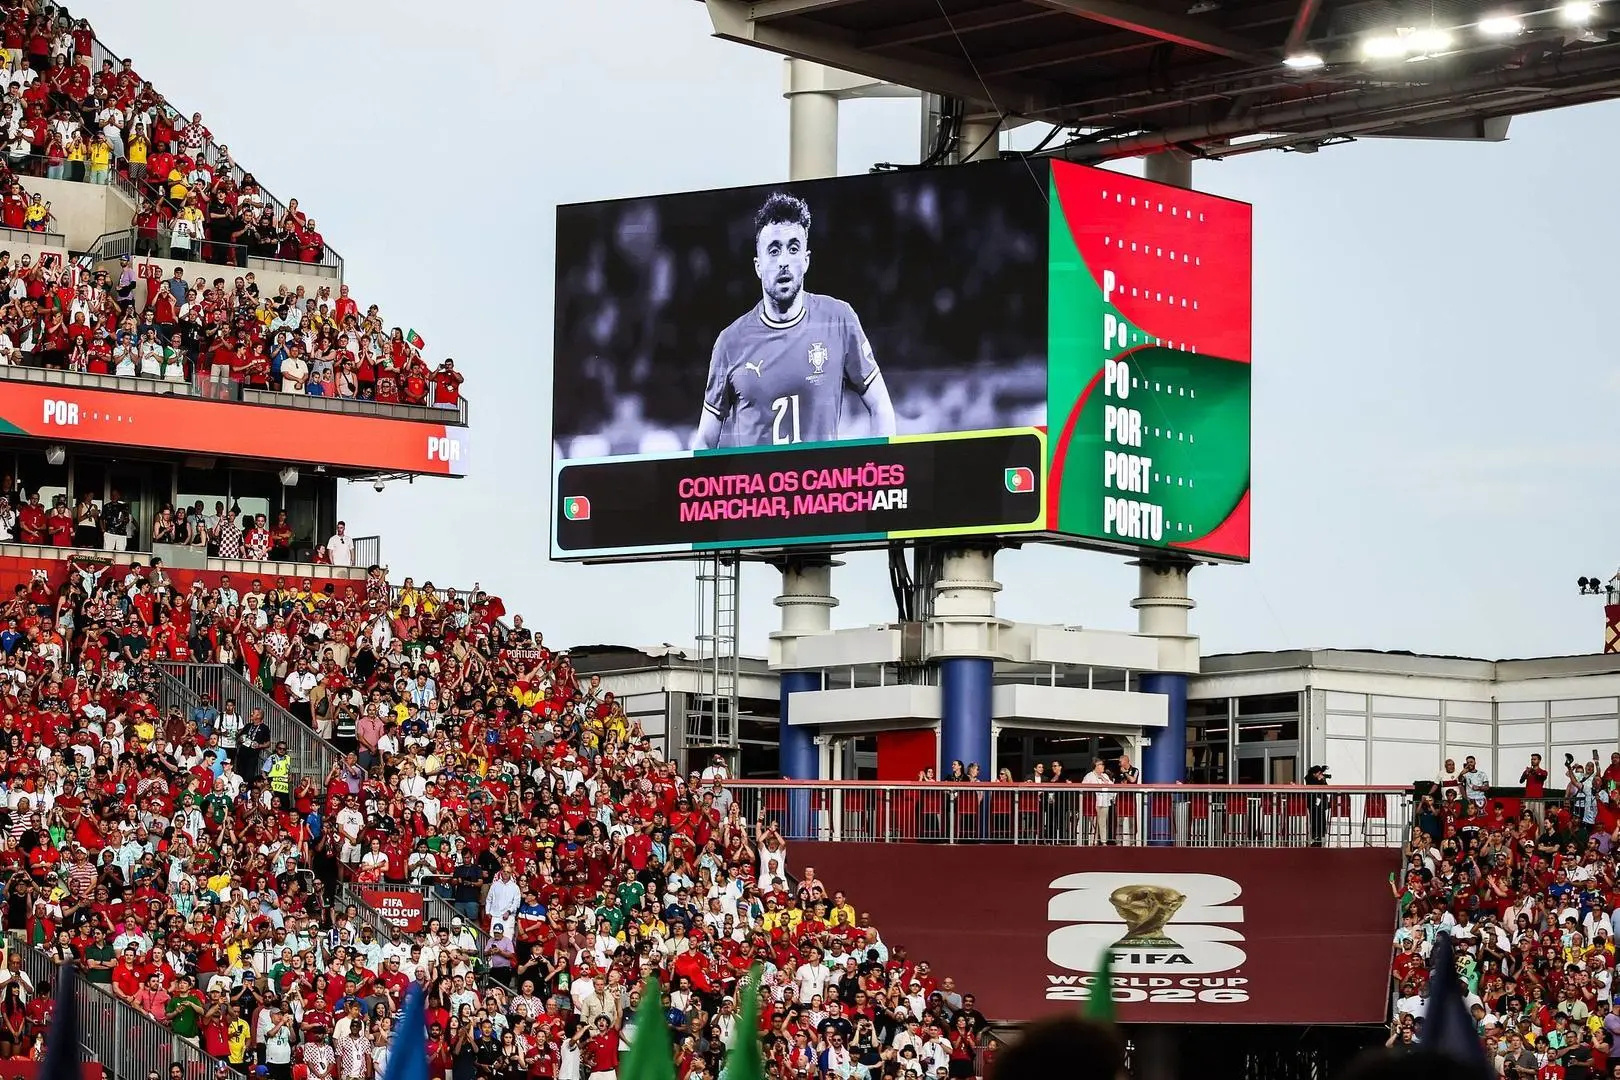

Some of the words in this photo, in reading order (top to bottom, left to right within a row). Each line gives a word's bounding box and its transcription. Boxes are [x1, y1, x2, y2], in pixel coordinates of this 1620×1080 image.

[771, 393, 803, 445] 21
[678, 472, 765, 499] CONTRA
[768, 470, 799, 492] OS
[801, 462, 905, 490] CANHÕES
[679, 495, 790, 523] MARCHAR,
[798, 487, 908, 514] MARCHAR!
[506, 649, 543, 660] PORTUGAL
[382, 898, 403, 907] FIFA
[373, 907, 400, 917] ORLD
[400, 908, 420, 918] CUP
[1111, 953, 1194, 965] FIFA
[1179, 977, 1249, 988] CUP
[1045, 986, 1250, 1004] 2026
